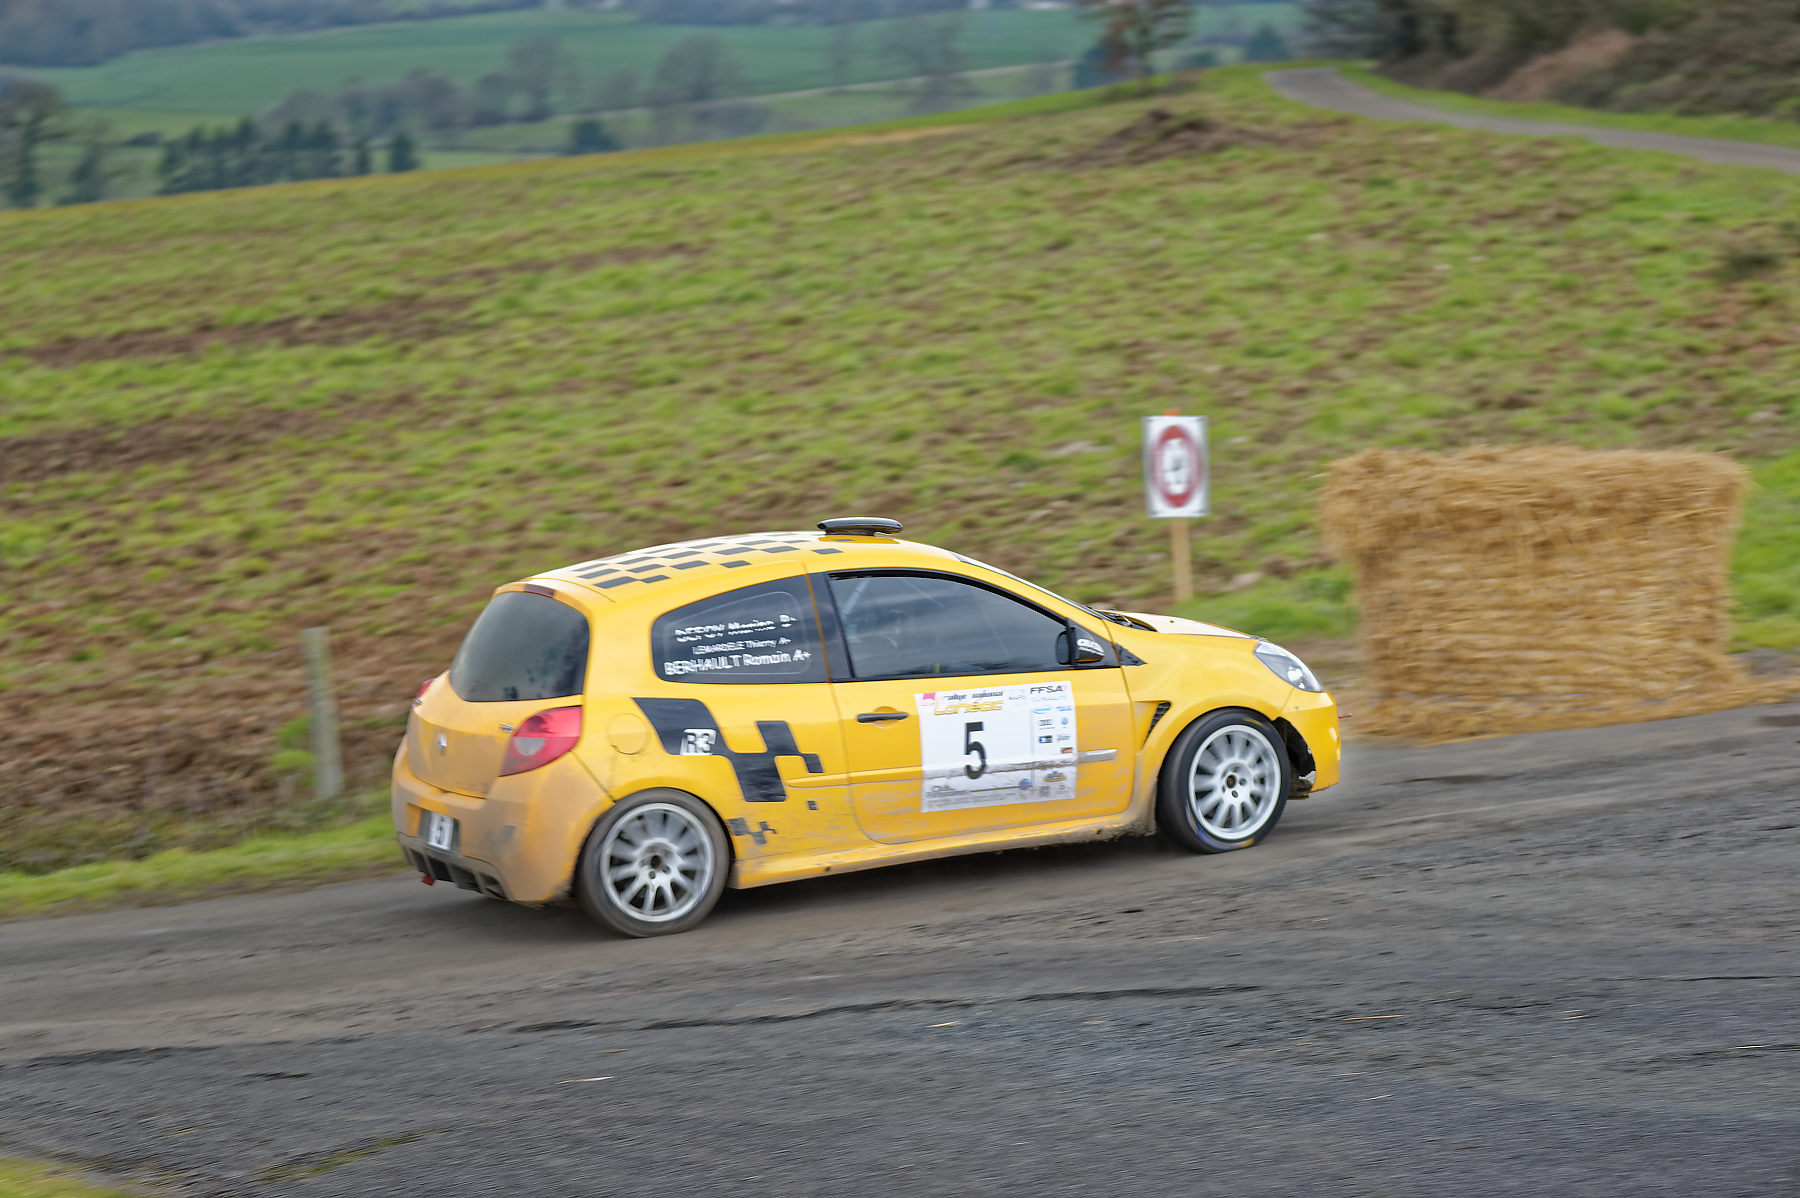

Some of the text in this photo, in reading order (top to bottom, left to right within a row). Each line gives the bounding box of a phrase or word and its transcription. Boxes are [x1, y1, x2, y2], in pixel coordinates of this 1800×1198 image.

[664, 649, 812, 676] BERHAULT Romain A+
[1030, 685, 1063, 694] FFSA
[680, 728, 717, 756] R3
[964, 721, 988, 780] 5
